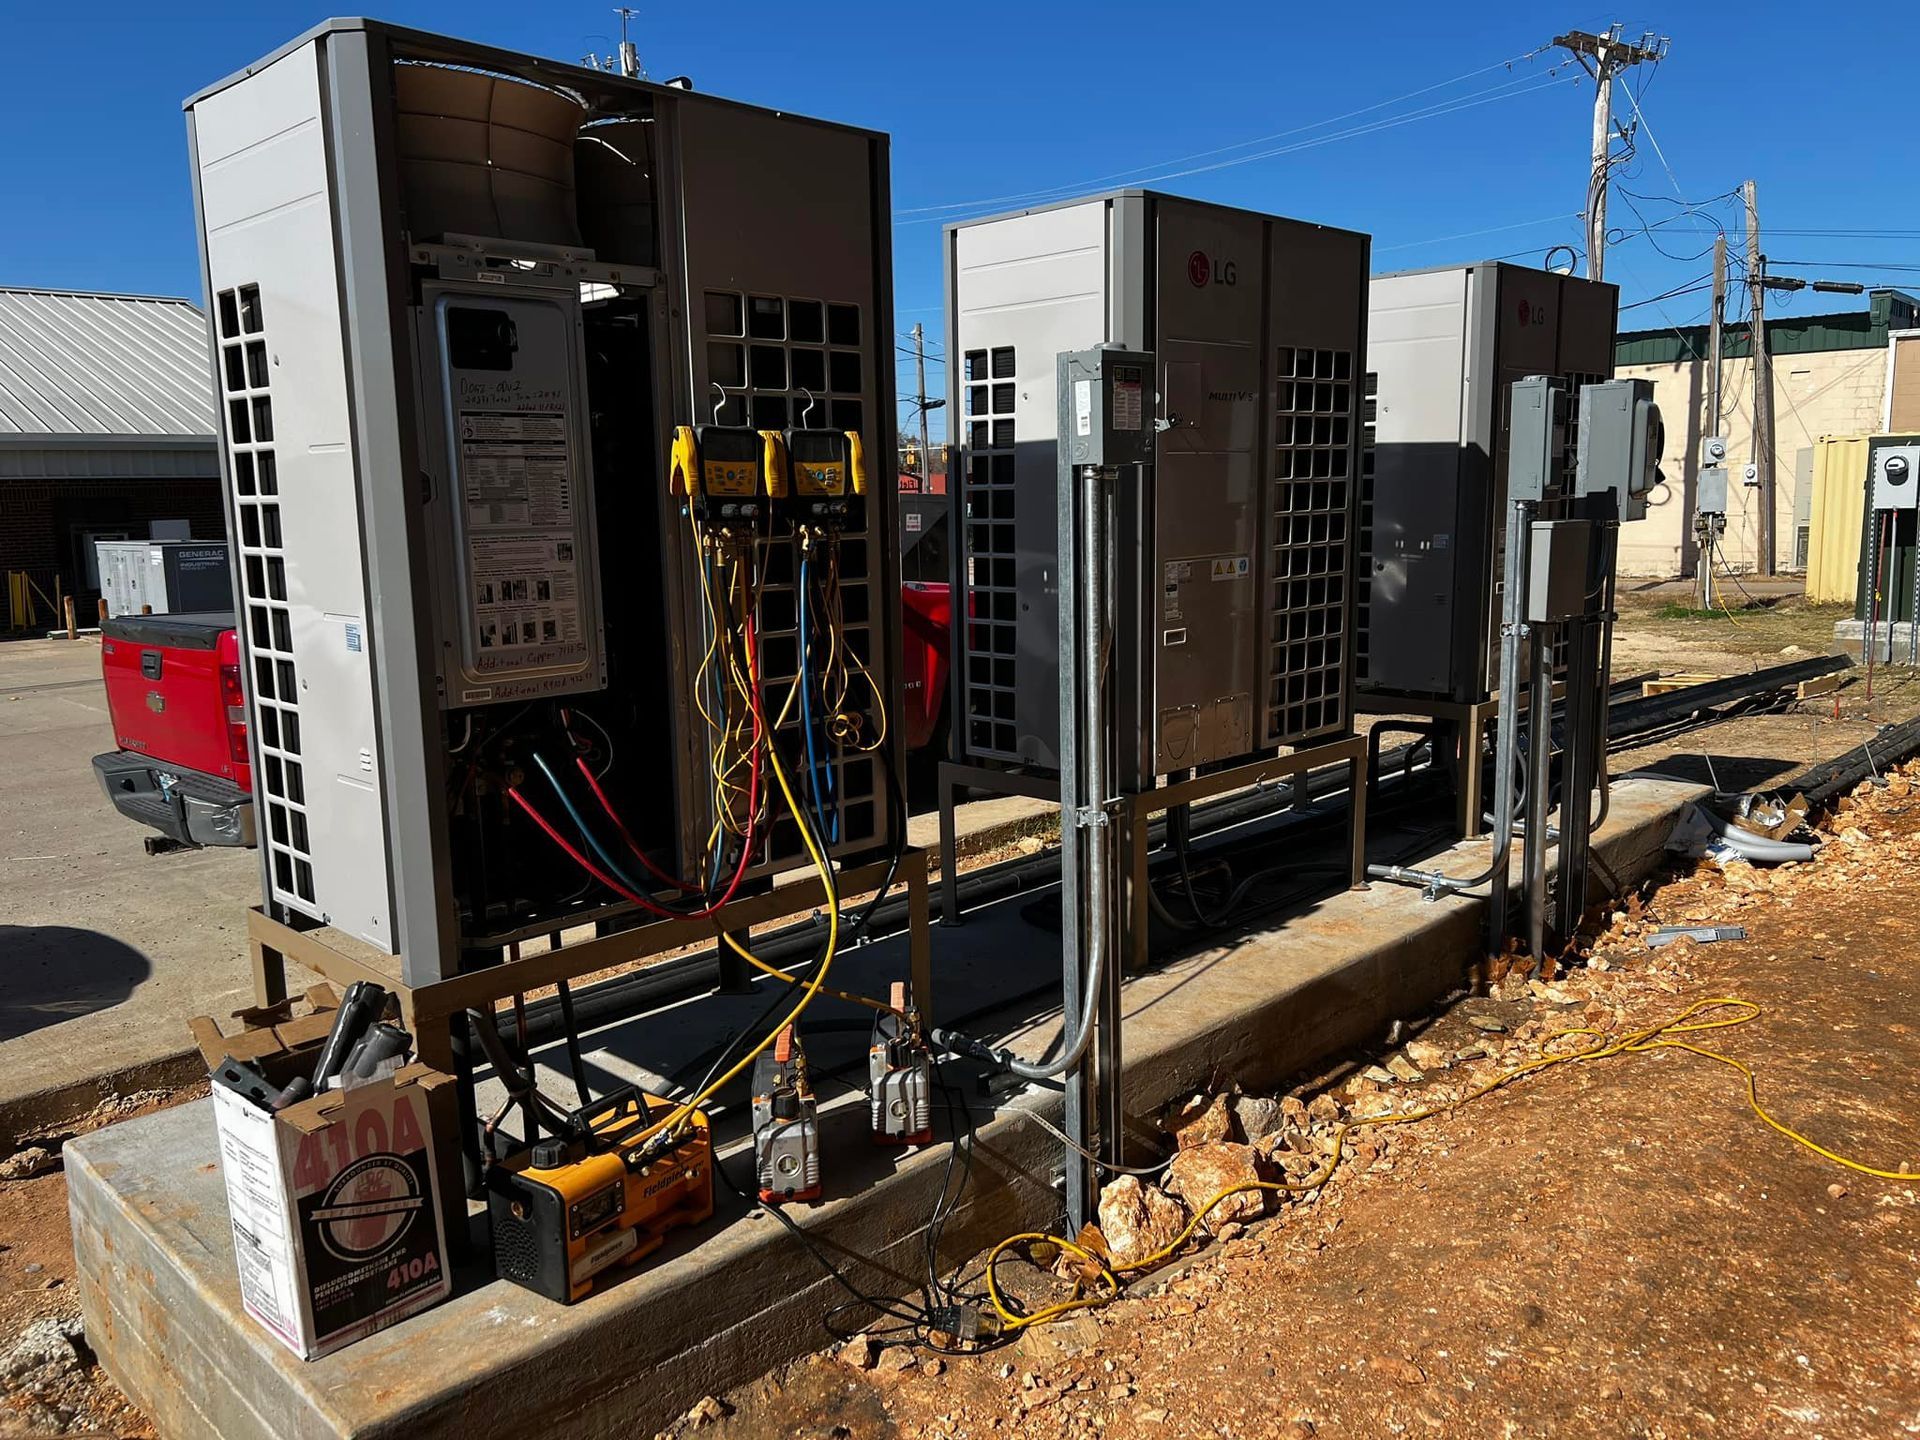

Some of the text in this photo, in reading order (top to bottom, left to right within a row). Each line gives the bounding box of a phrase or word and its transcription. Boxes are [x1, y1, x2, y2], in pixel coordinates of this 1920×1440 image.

[1214, 260, 1236, 286] LG
[1531, 306, 1544, 325] LG
[178, 549, 225, 558] GENERAC
[292, 1095, 426, 1191] 410A
[386, 1251, 440, 1290] 410A
